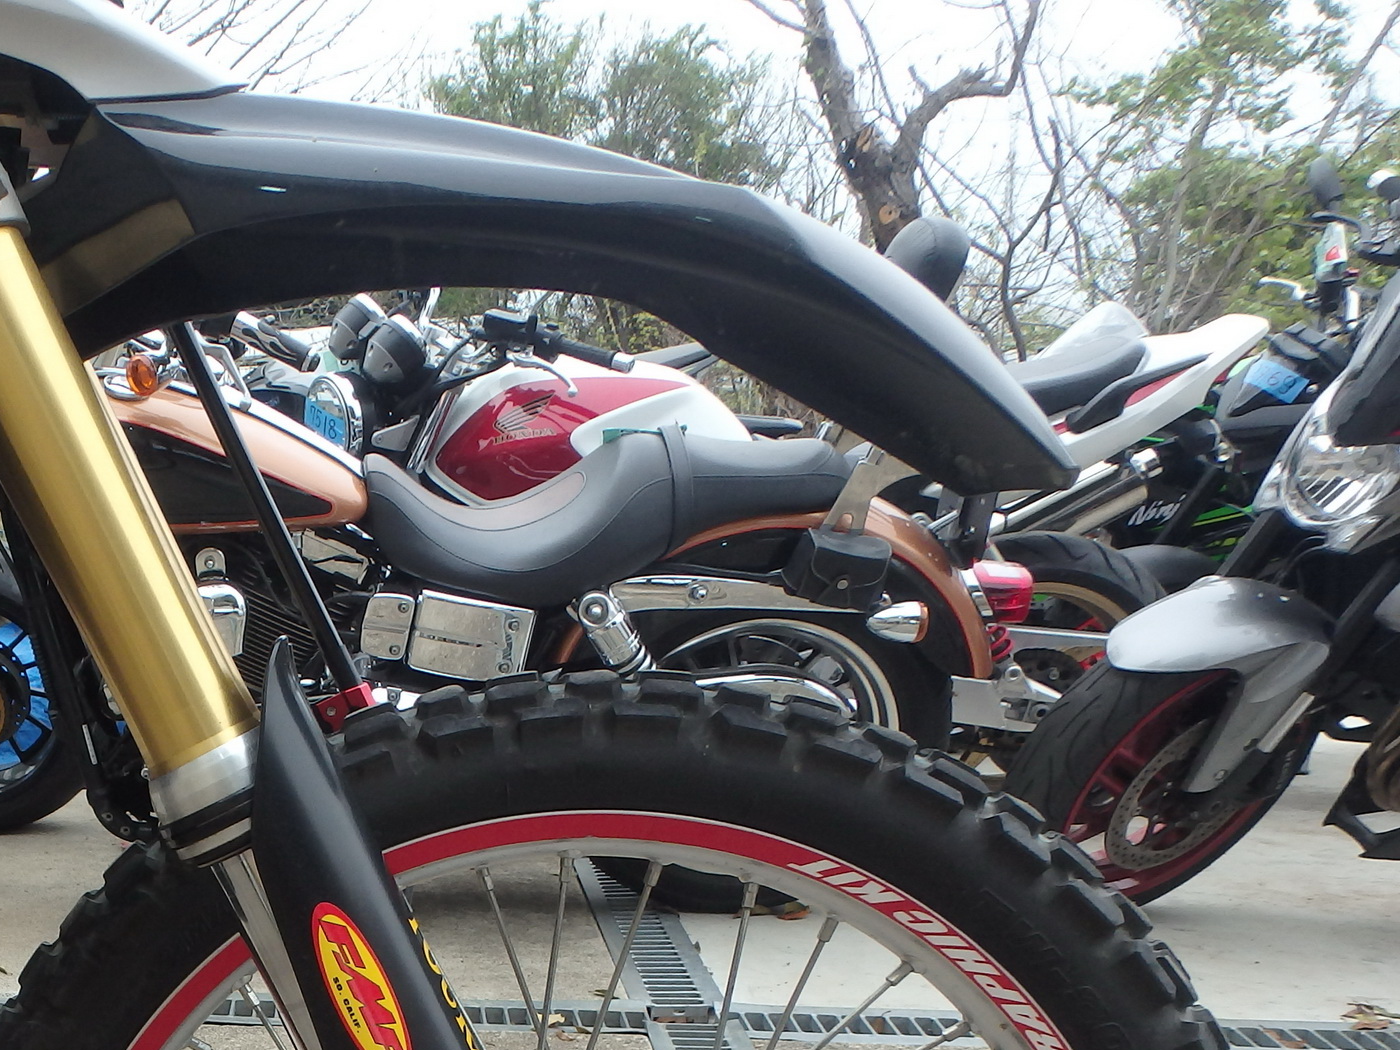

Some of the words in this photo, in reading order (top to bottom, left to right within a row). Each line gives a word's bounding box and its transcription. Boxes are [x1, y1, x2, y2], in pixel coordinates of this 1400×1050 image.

[310, 404, 337, 440] 7518
[493, 427, 557, 446] HONDA
[1128, 491, 1187, 526] Ninj
[788, 858, 905, 906] KIT
[343, 998, 362, 1033] CALIF.
